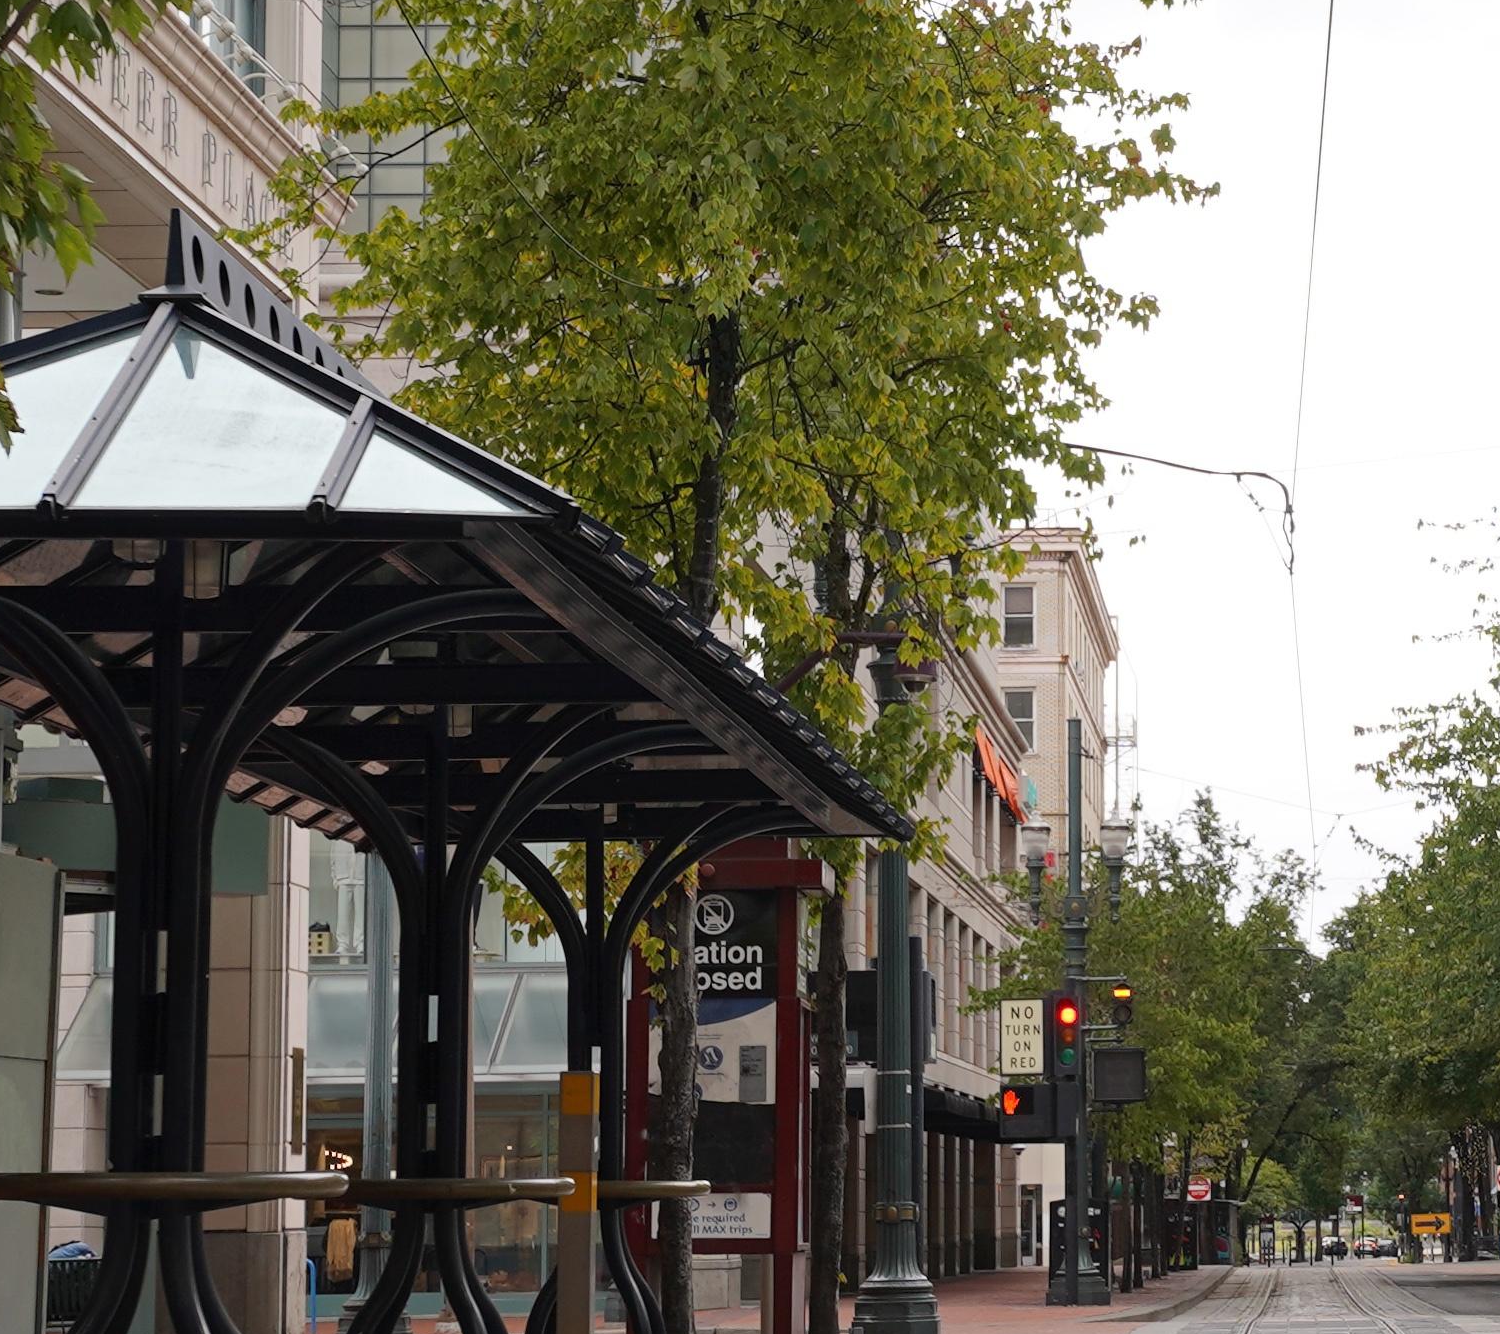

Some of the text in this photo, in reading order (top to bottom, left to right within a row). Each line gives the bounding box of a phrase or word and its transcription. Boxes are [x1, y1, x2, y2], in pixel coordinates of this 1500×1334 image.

[694, 940, 763, 964] ation
[697, 966, 763, 991] osed
[1011, 1006, 1034, 1019] NO
[1005, 1024, 1041, 1036] TURN
[1013, 1040, 1031, 1052] ON
[1010, 1056, 1037, 1068] RED
[702, 1213, 746, 1225] required
[702, 1225, 726, 1234] MAX
[729, 1224, 753, 1236] trips
